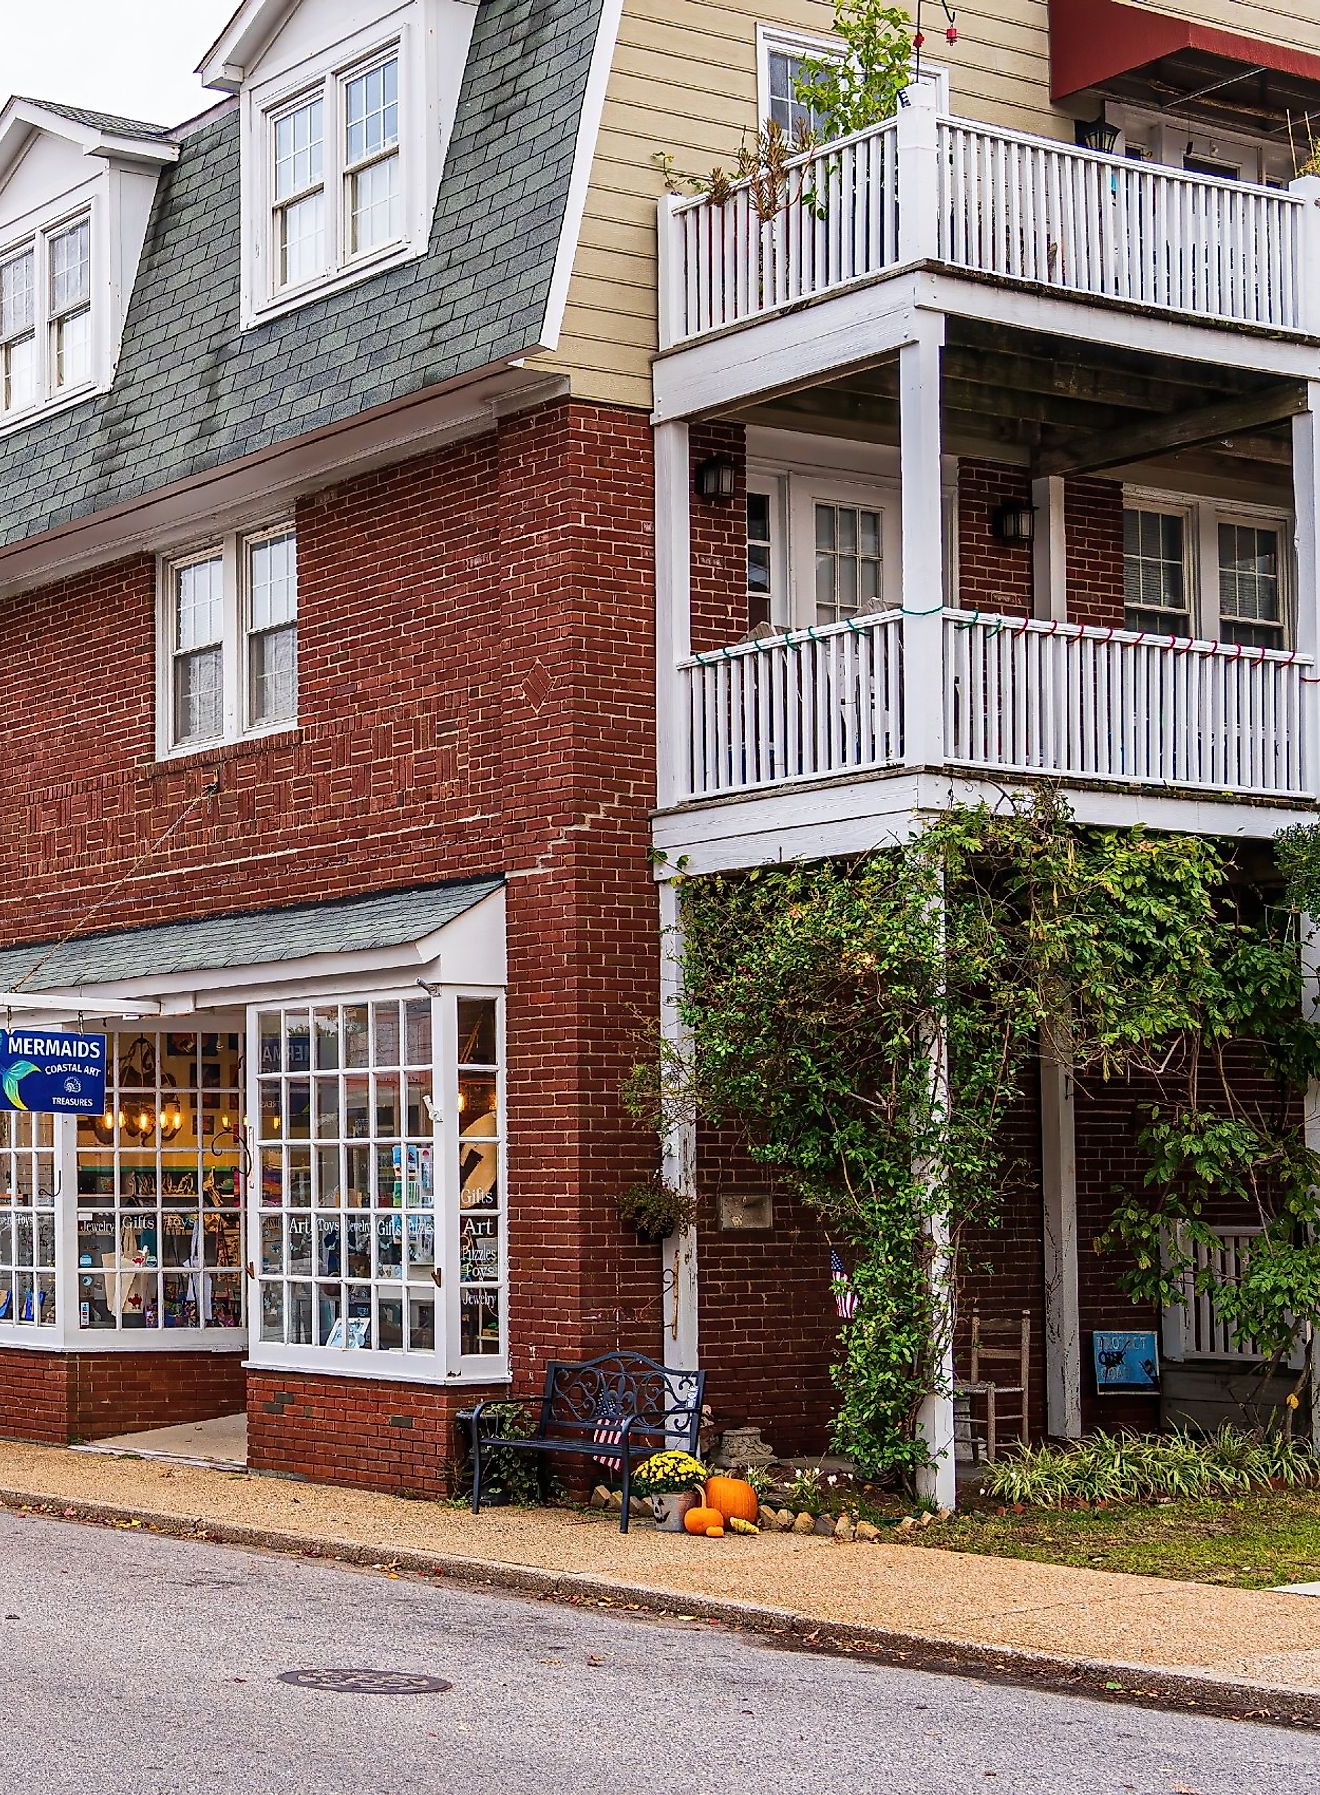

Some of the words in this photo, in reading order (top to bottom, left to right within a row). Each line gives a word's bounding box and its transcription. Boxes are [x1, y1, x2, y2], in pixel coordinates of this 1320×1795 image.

[8, 1036, 101, 1059] MERMAIDS
[44, 1063, 82, 1075] COASTAL
[83, 1065, 101, 1077] ART
[51, 1096, 94, 1107] TREASURES
[461, 1187, 494, 1204] Gifts
[81, 1219, 115, 1235] Jewelry
[122, 1215, 155, 1231] Gifts
[289, 1217, 311, 1234] Art
[317, 1218, 340, 1235] Toys
[378, 1219, 402, 1236] Gifts
[462, 1217, 495, 1236] Art
[461, 1243, 497, 1261] Puzzles
[462, 1264, 495, 1283] Toys
[462, 1291, 497, 1310] Jewelry
